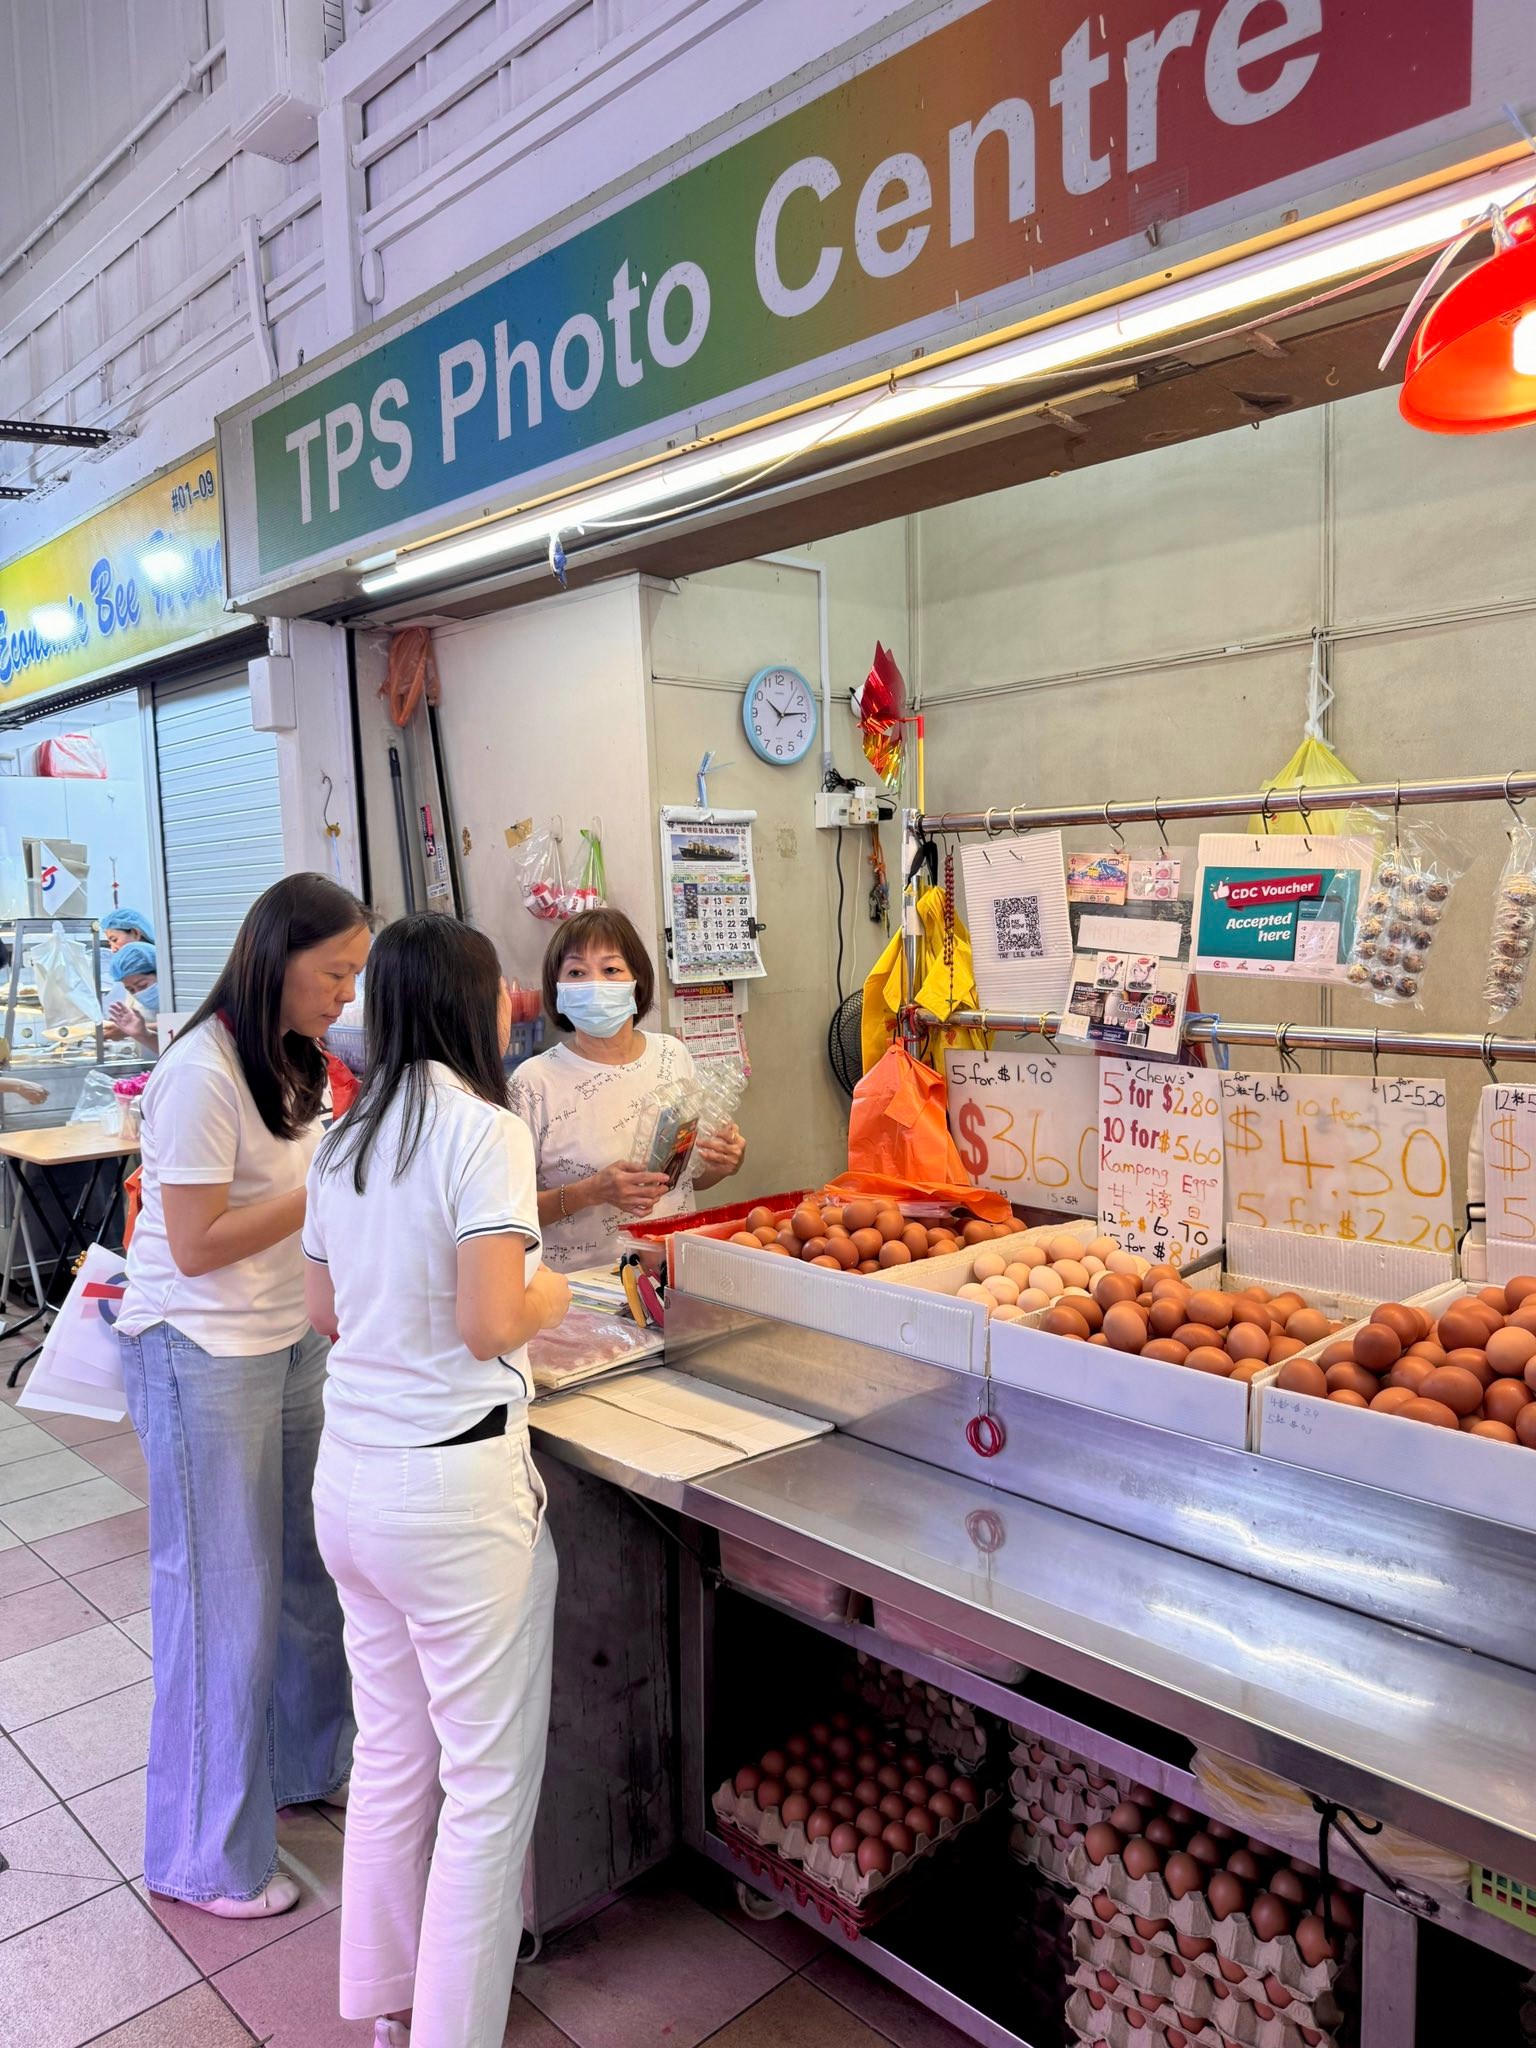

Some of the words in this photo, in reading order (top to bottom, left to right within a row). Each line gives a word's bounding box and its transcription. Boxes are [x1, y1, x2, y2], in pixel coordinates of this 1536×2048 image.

[286, 378, 412, 524] TPS
[439, 258, 711, 464] Photo
[755, 0, 1324, 318] Centre
[170, 470, 215, 512] #01-09
[91, 557, 140, 636] Bee
[764, 677, 772, 688] 11
[775, 674, 785, 686] 12
[754, 690, 764, 701] 10
[797, 695, 804, 706] 2
[751, 707, 758, 718] 9
[800, 712, 807, 723] 3
[755, 725, 763, 736] 8
[796, 730, 803, 739] 4
[764, 739, 771, 750] 7
[775, 745, 783, 755] 6
[787, 741, 795, 752] 5
[1231, 886, 1259, 900] CDC
[1261, 881, 1315, 897] Voucher
[713, 897, 722, 905] 13
[739, 897, 747, 905] 27
[702, 909, 707, 917] 7
[714, 909, 722, 917] 14
[726, 909, 735, 917] 21
[740, 908, 748, 916] 28
[727, 920, 736, 928] 22
[740, 920, 749, 928] 29
[1226, 912, 1293, 930] Accepted
[691, 933, 697, 941] 2
[703, 932, 709, 940] 9
[715, 932, 724, 940] 16
[728, 931, 737, 939] 23
[741, 931, 750, 939] 30
[1257, 929, 1291, 943] here
[703, 944, 712, 952] 10
[716, 943, 725, 951] 17
[742, 942, 751, 950] 31
[1119, 1003, 1146, 1015] Omega
[951, 1064, 967, 1085] 5
[1134, 1062, 1186, 1085] Chew's
[1233, 1071, 1251, 1082] for
[1396, 1077, 1415, 1087] for
[1103, 1071, 1124, 1105] 5
[1129, 1078, 1153, 1109] for
[1296, 1100, 1320, 1117] 10
[1331, 1096, 1362, 1122] for
[1103, 1116, 1125, 1144] 10
[1130, 1119, 1160, 1149] for
[1100, 1144, 1169, 1188] Kampong
[1182, 1174, 1219, 1201] Eggs
[1102, 1210, 1117, 1225] 12
[1119, 1211, 1134, 1228] for
[1236, 1191, 1267, 1229] 5
[1283, 1197, 1330, 1237] for
[1499, 1196, 1536, 1240] 5
[1124, 1232, 1146, 1253] for
